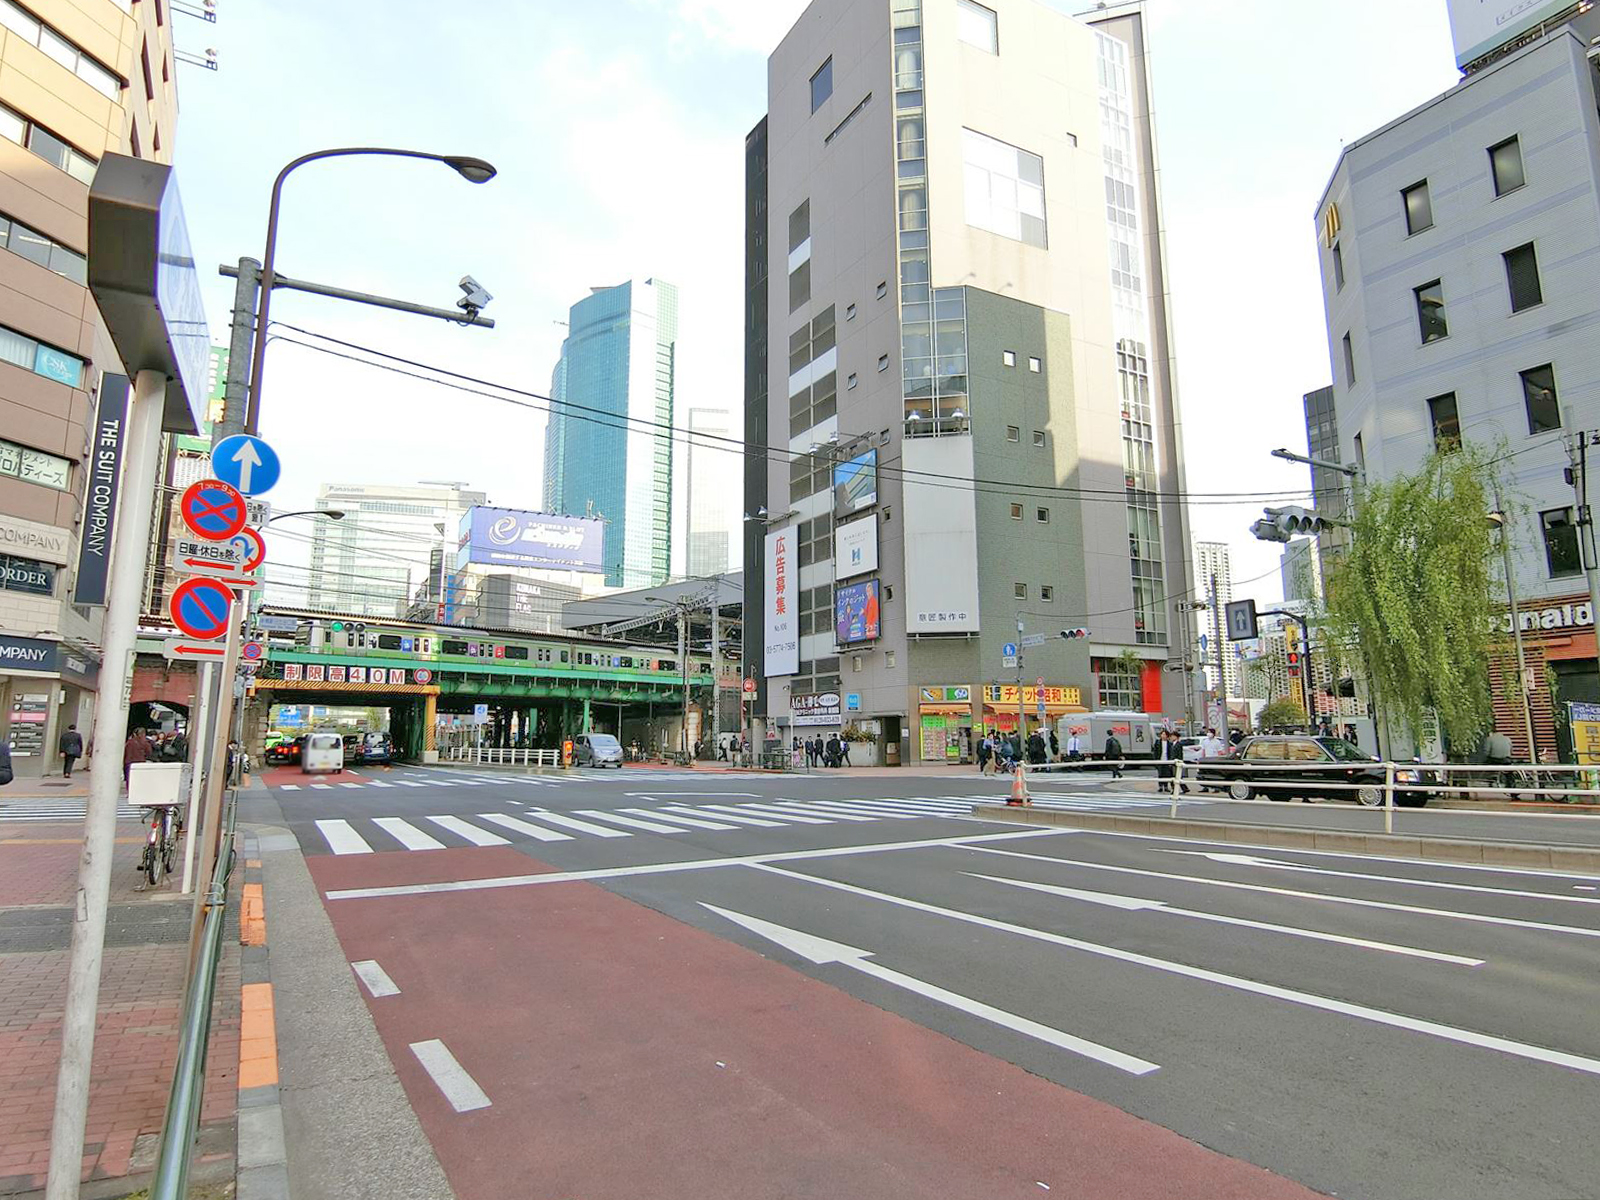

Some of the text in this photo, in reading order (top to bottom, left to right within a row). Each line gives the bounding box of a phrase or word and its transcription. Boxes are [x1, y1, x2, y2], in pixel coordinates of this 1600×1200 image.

[88, 420, 120, 557] THE SUIT COMPANY
[776, 536, 786, 615] 広告募集
